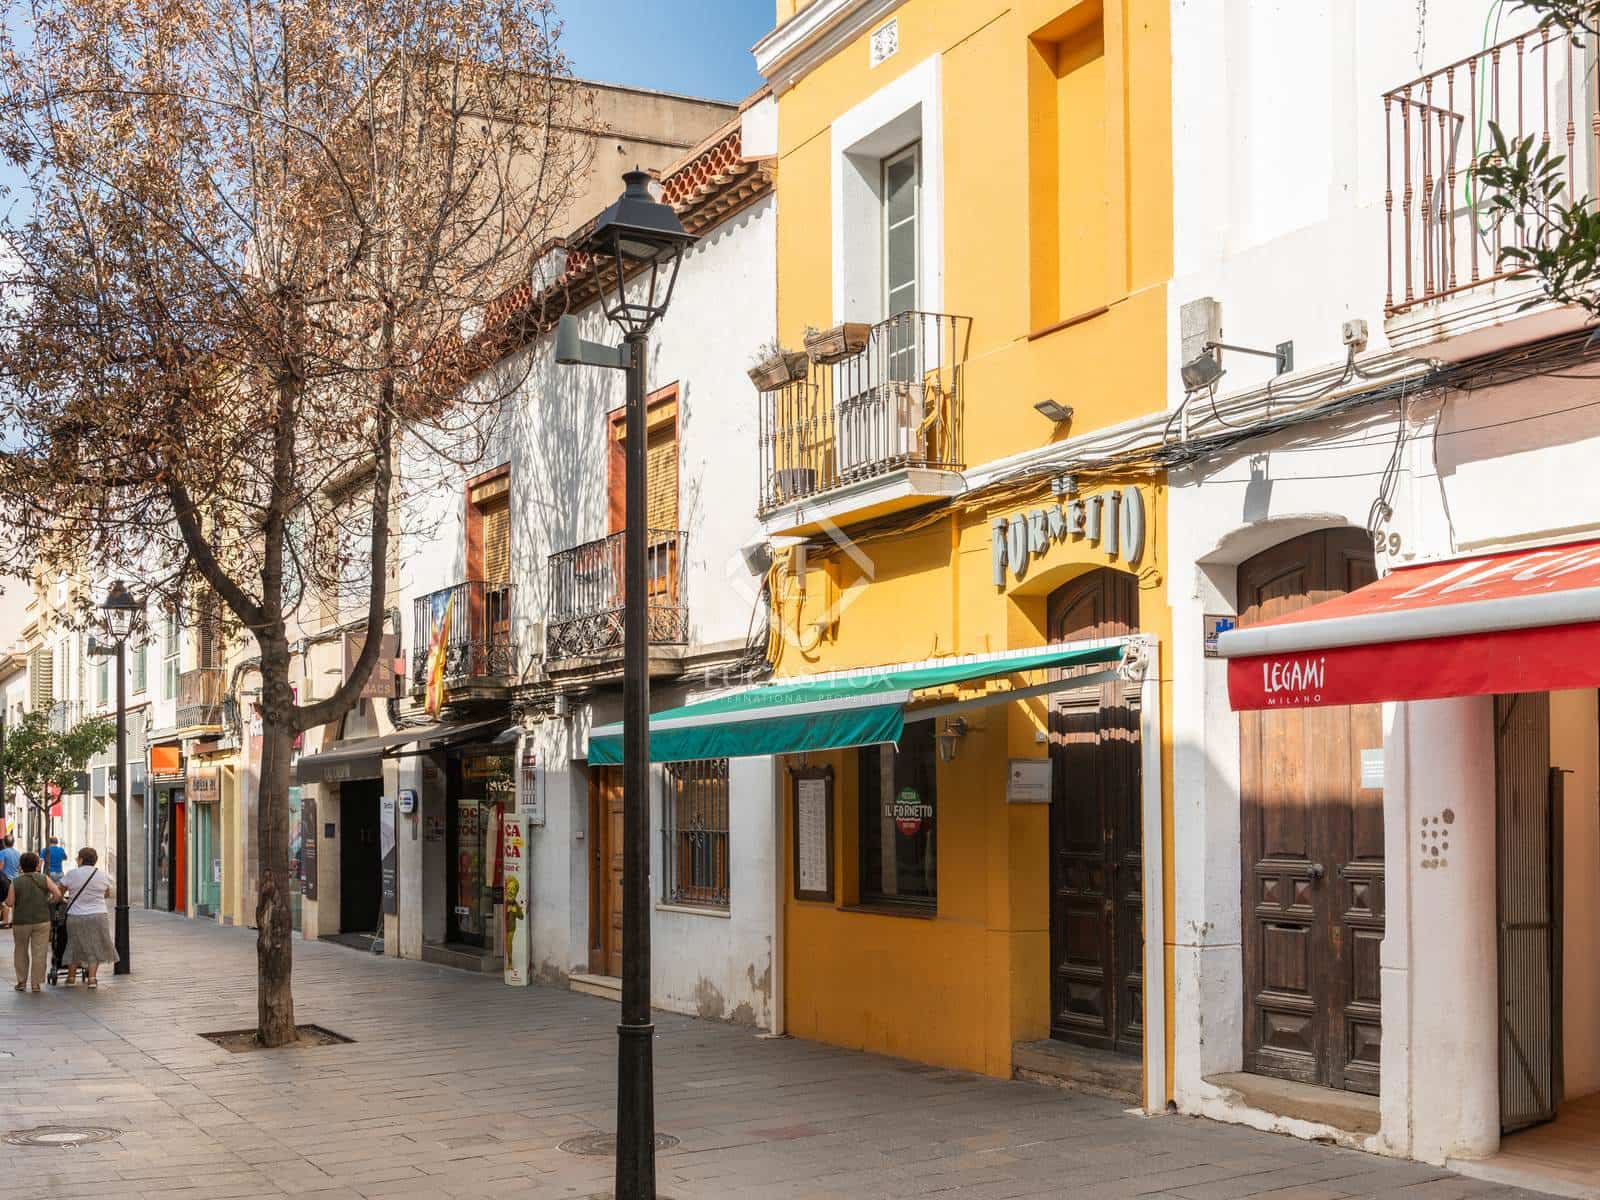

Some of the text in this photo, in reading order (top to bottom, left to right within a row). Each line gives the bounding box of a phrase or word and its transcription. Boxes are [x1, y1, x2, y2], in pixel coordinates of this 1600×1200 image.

[992, 485, 1145, 586] FORNETTO
[1375, 530, 1401, 556] 29
[1268, 694, 1321, 705] MILANO
[893, 804, 933, 818] FORNETTO
